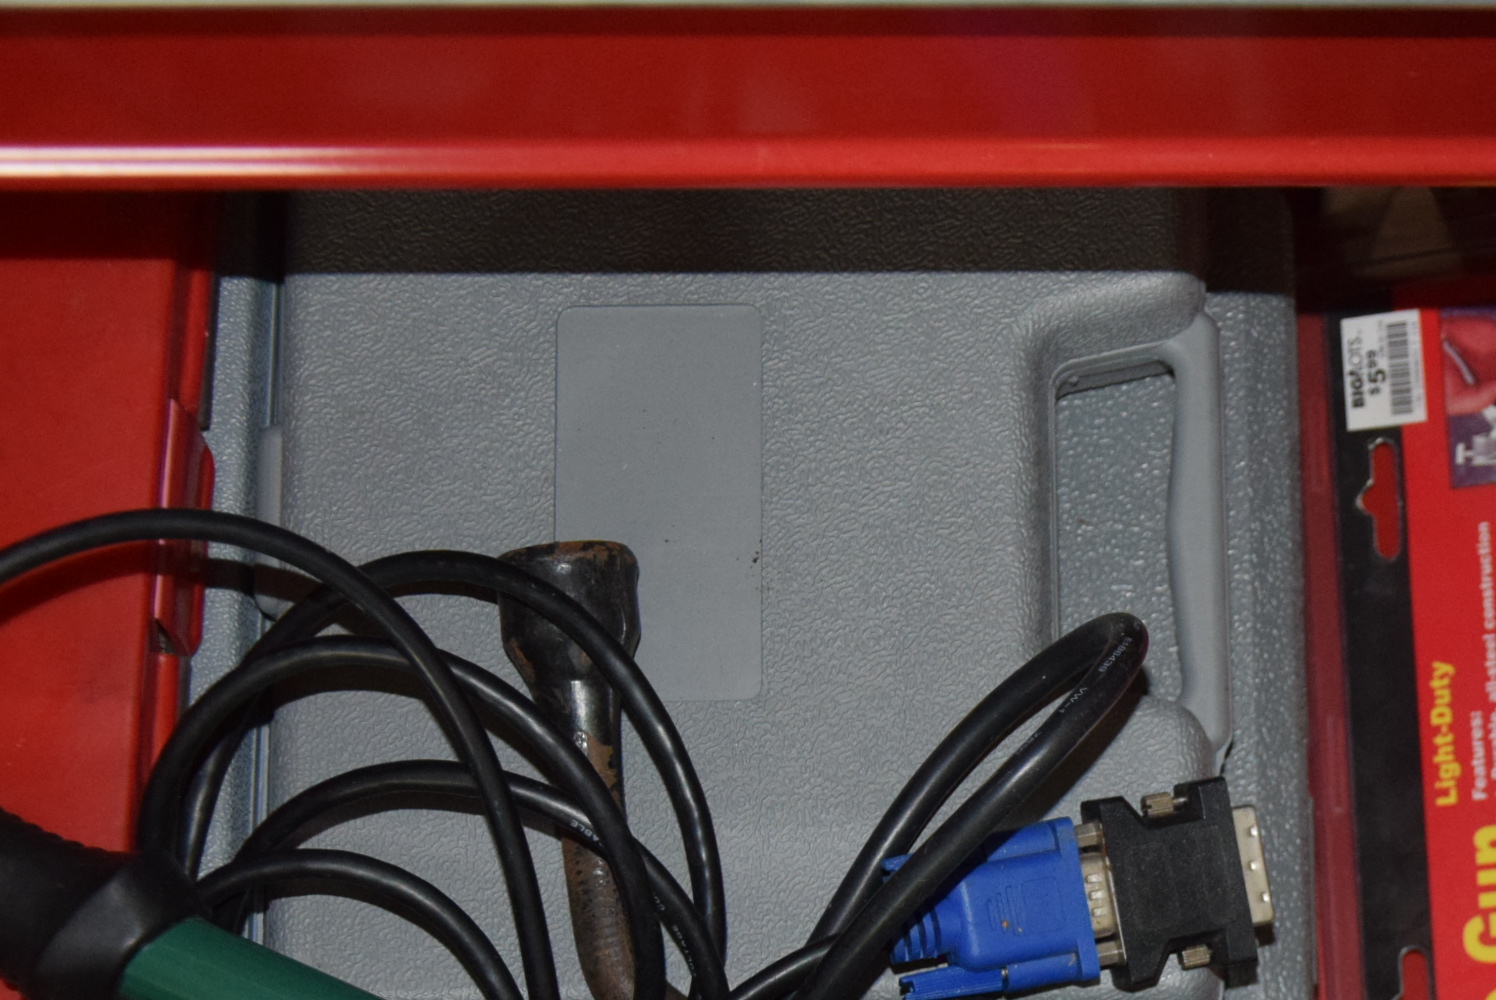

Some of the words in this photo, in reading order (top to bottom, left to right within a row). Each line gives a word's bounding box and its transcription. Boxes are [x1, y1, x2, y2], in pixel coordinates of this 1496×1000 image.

[1477, 521, 1496, 629] construction
[1430, 661, 1461, 806] Light-Duty
[1470, 710, 1488, 800] Features:
[570, 819, 603, 846] ABLE
